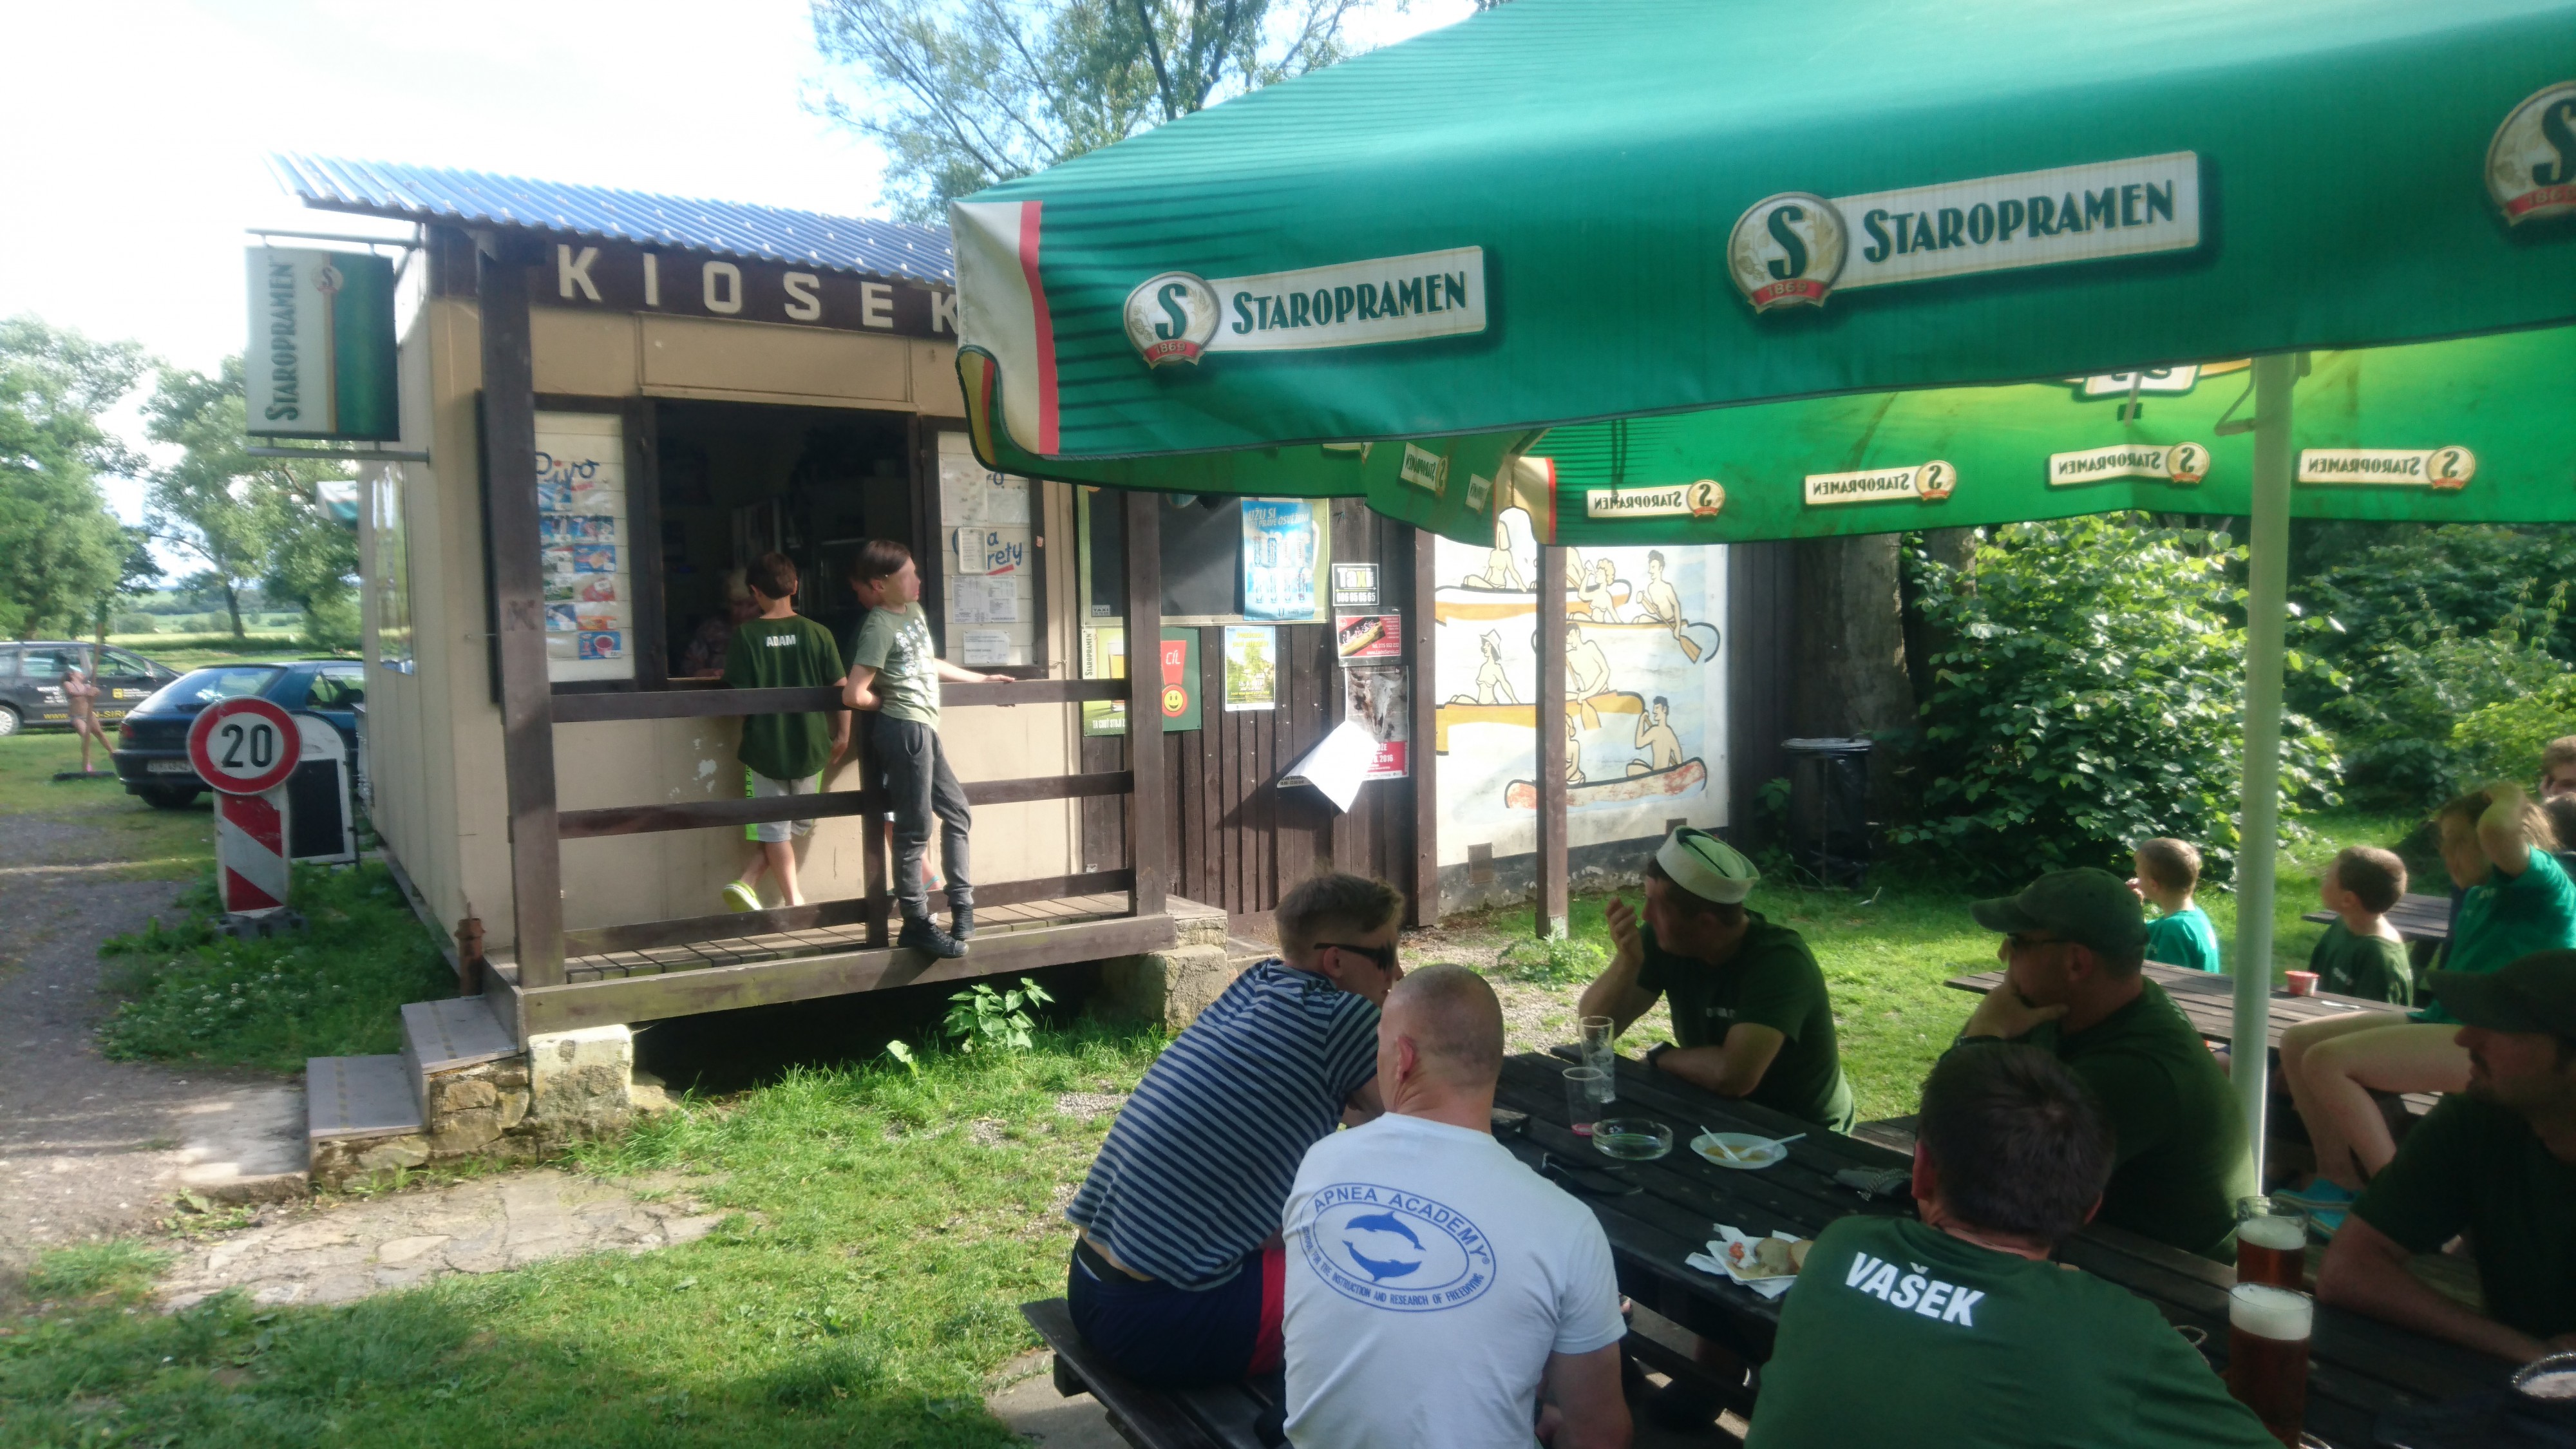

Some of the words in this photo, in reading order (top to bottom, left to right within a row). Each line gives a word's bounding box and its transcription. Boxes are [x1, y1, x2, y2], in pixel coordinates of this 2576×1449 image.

[1863, 180, 2174, 263] STAROPRAMEN
[558, 243, 958, 334] KIOSEK
[1232, 270, 1467, 335] STAROPRAMEN
[265, 261, 298, 421] STAROPRAMEN
[1155, 343, 1186, 354] 1869
[766, 634, 796, 647] ADAM
[1085, 632, 1094, 676] STAROPRAMEN
[1166, 650, 1181, 665] CÍL
[221, 724, 273, 768] 20
[1313, 1186, 1378, 1213] APNEA
[1320, 1262, 1332, 1277] THE
[1331, 1272, 1371, 1298] INSTRUCTION
[1374, 1290, 1387, 1302] AND
[1390, 1293, 1429, 1305] RESEARCH
[1432, 1293, 1442, 1304] OF
[1444, 1273, 1484, 1302] FREEDIVING
[1845, 1251, 1986, 1327] VAŠEK
